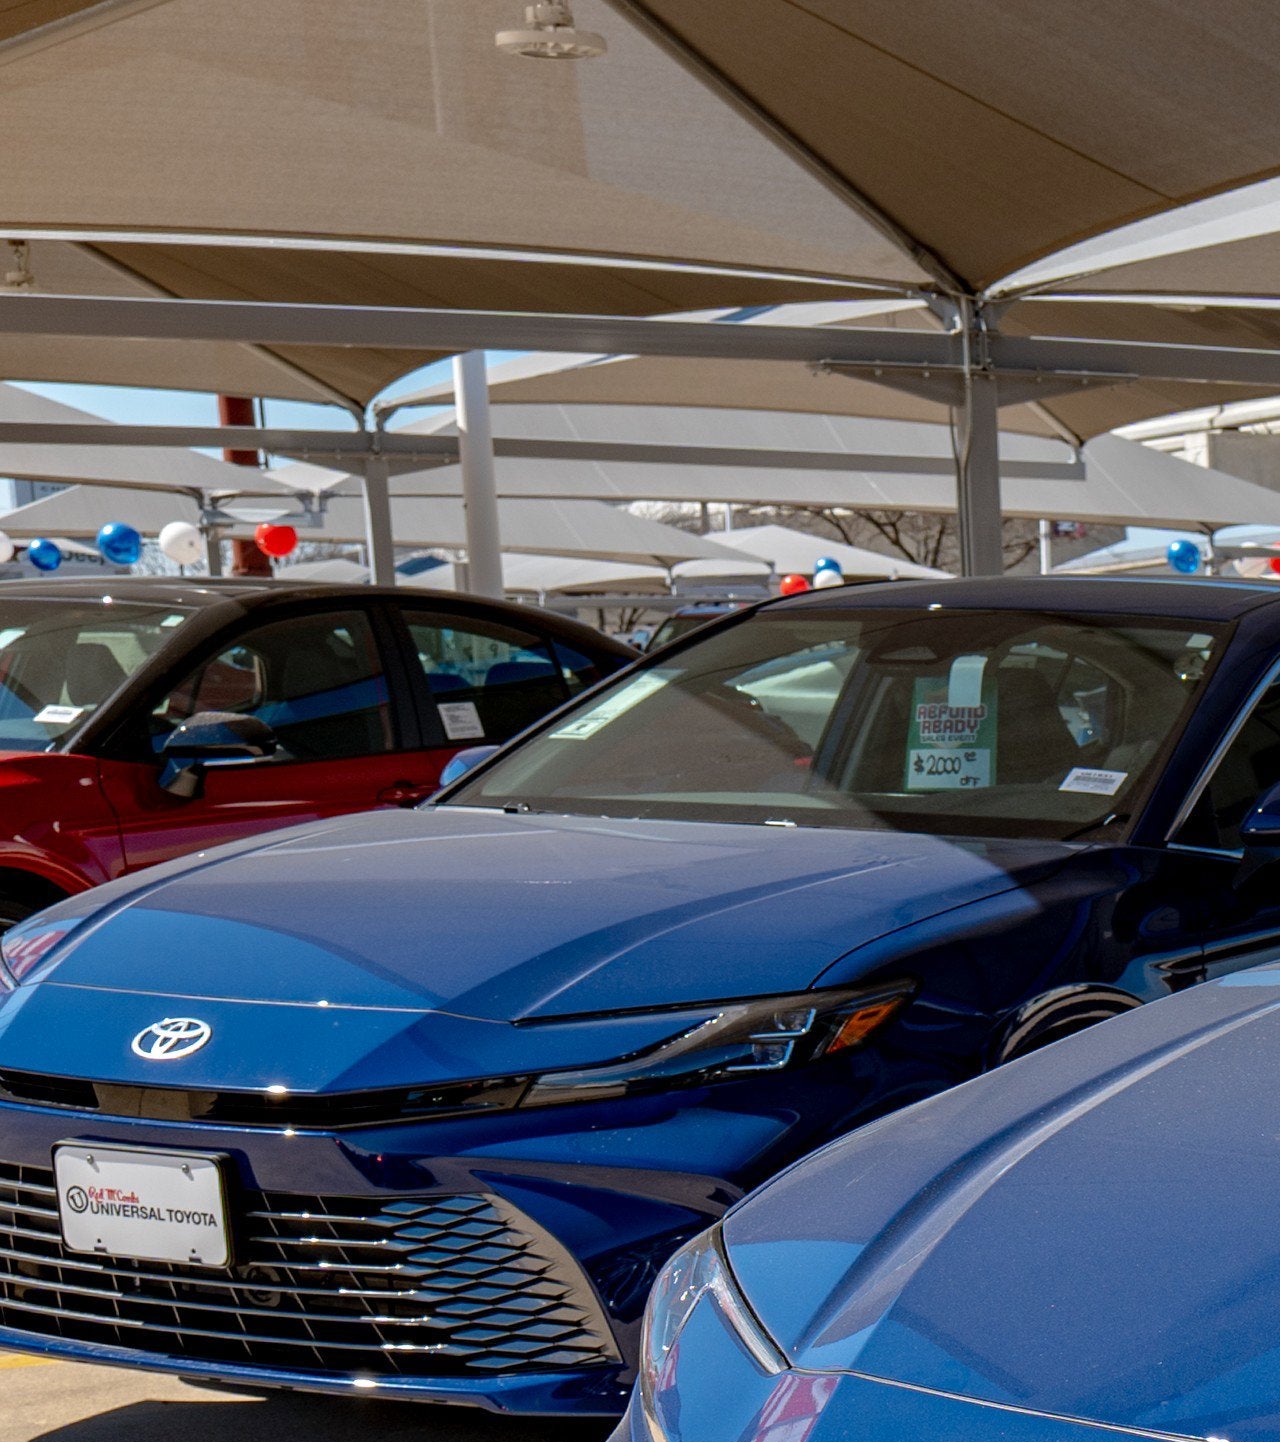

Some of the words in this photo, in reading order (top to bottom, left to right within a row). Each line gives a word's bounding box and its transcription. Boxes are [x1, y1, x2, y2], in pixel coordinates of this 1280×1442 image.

[922, 719, 978, 734] READY
[90, 1201, 166, 1221] UNIVERSAL
[166, 1209, 218, 1227] TOYOTA
